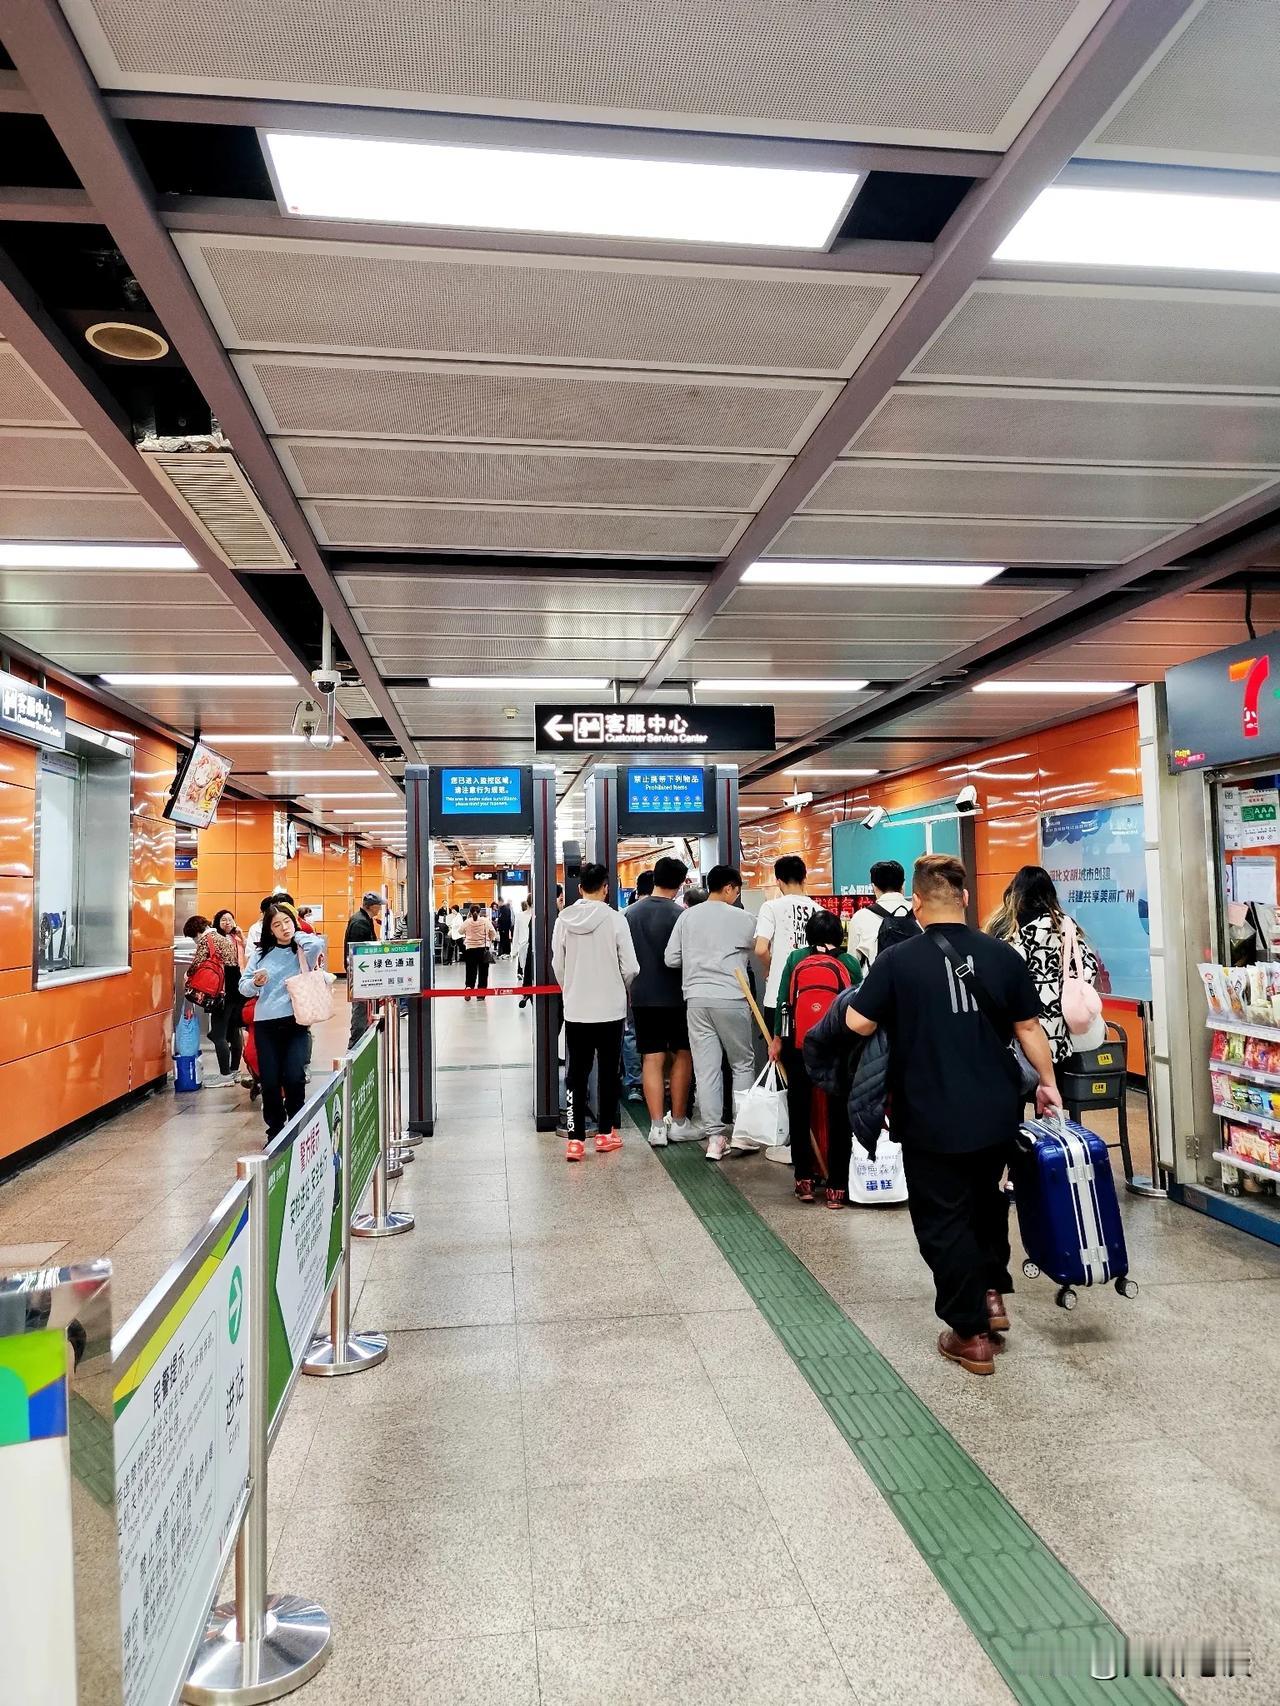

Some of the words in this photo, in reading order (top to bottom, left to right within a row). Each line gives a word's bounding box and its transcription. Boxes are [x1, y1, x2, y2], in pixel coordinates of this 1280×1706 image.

[605, 713, 689, 734] 客服中心
[604, 734, 646, 743] Customer
[647, 734, 678, 743] Service
[679, 734, 708, 743] Center
[633, 775, 699, 784] 禁止携带下列物品
[1068, 889, 1135, 903] 共建共享美丽广州
[373, 957, 415, 969] 绿色通道
[566, 1104, 575, 1132] YONEX
[866, 1179, 893, 1191] 蛋糕
[153, 1338, 184, 1419] 民警提示
[226, 1357, 244, 1434] 进站
[139, 1451, 193, 1585] 禁止携带下列物品
